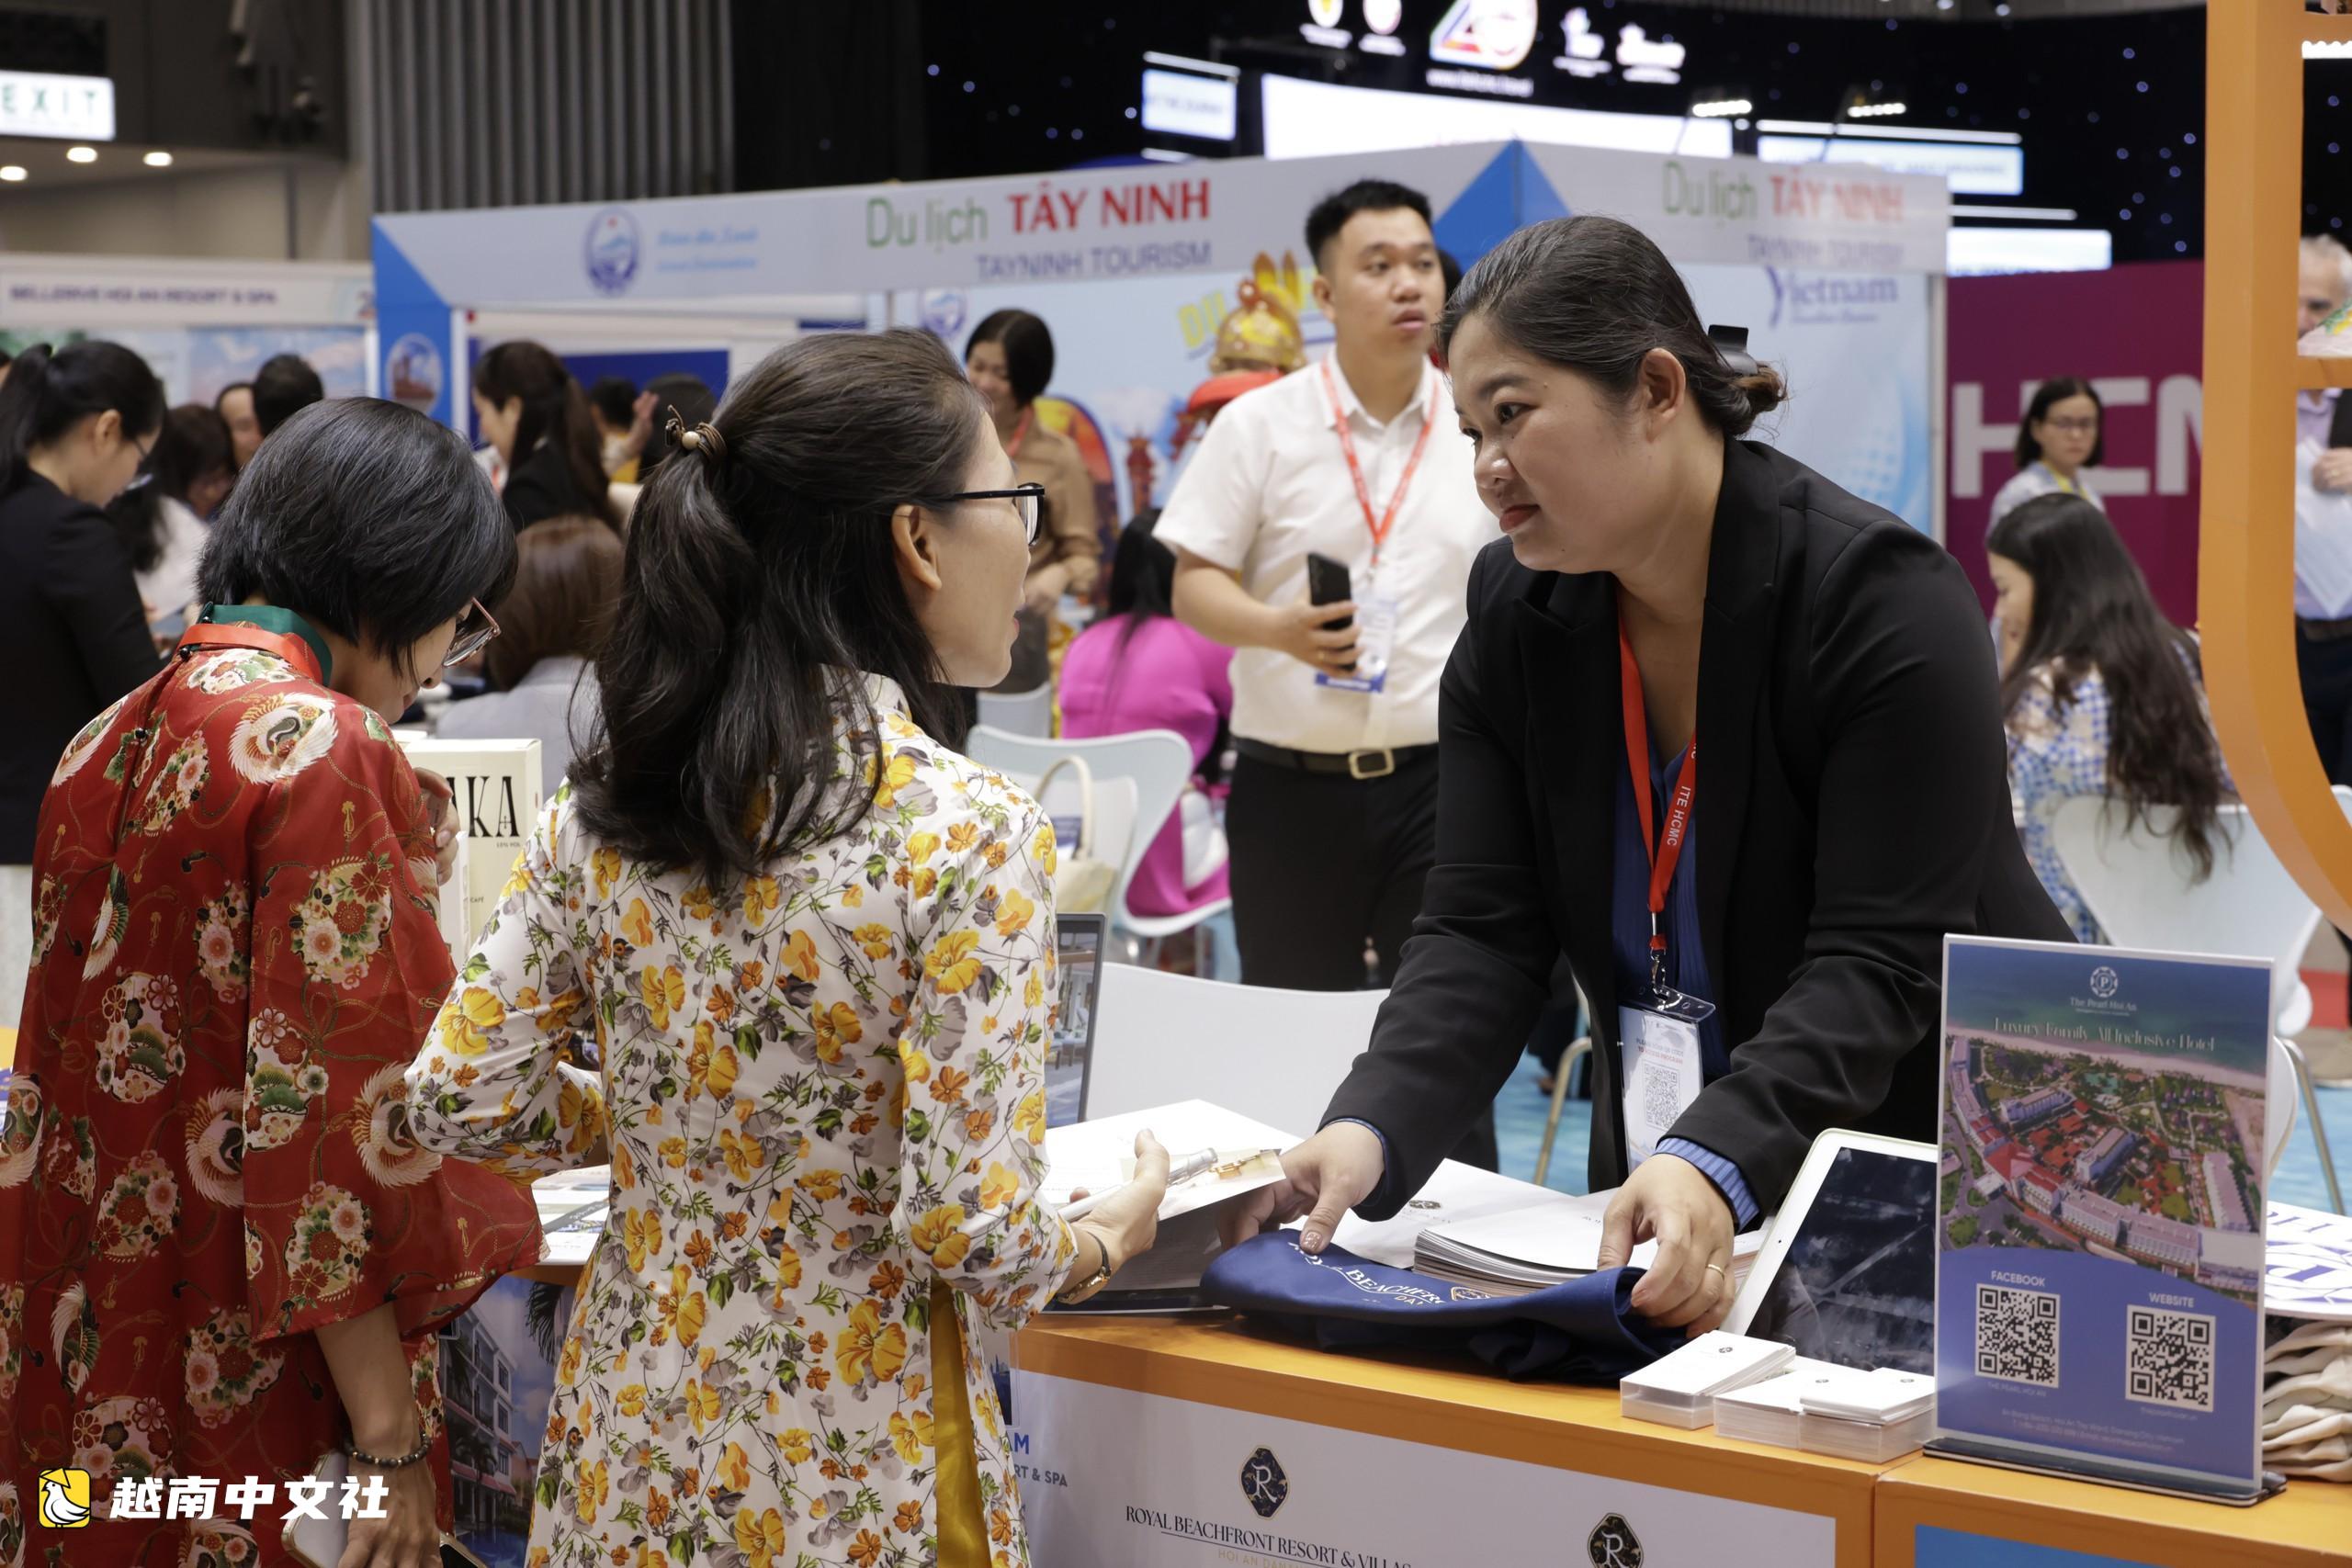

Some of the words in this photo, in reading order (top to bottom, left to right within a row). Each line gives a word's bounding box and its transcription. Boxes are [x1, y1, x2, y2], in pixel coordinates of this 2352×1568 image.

[2, 83, 98, 116] EXIT
[866, 197, 916, 249] Du
[1007, 181, 1086, 234] TÂY
[1101, 178, 1212, 226] NINH
[976, 252, 1084, 280] TAYNINH
[1091, 241, 1213, 274] TOURISM
[1676, 785, 1691, 808] ITE
[1667, 808, 1685, 846] HCMC
[1345, 1269, 1447, 1303] BEACHFR
[1991, 1270, 2045, 1287] FACEBOOK
[2149, 1292, 2196, 1309] WEBSITE
[1032, 1468, 1040, 1481] &
[1045, 1471, 1068, 1486] SPA
[1125, 1506, 1172, 1531] ROYAL
[1173, 1516, 1275, 1552] BEACHFRONT
[1278, 1537, 1338, 1564] RESORT
[1340, 1551, 1355, 1568] &
